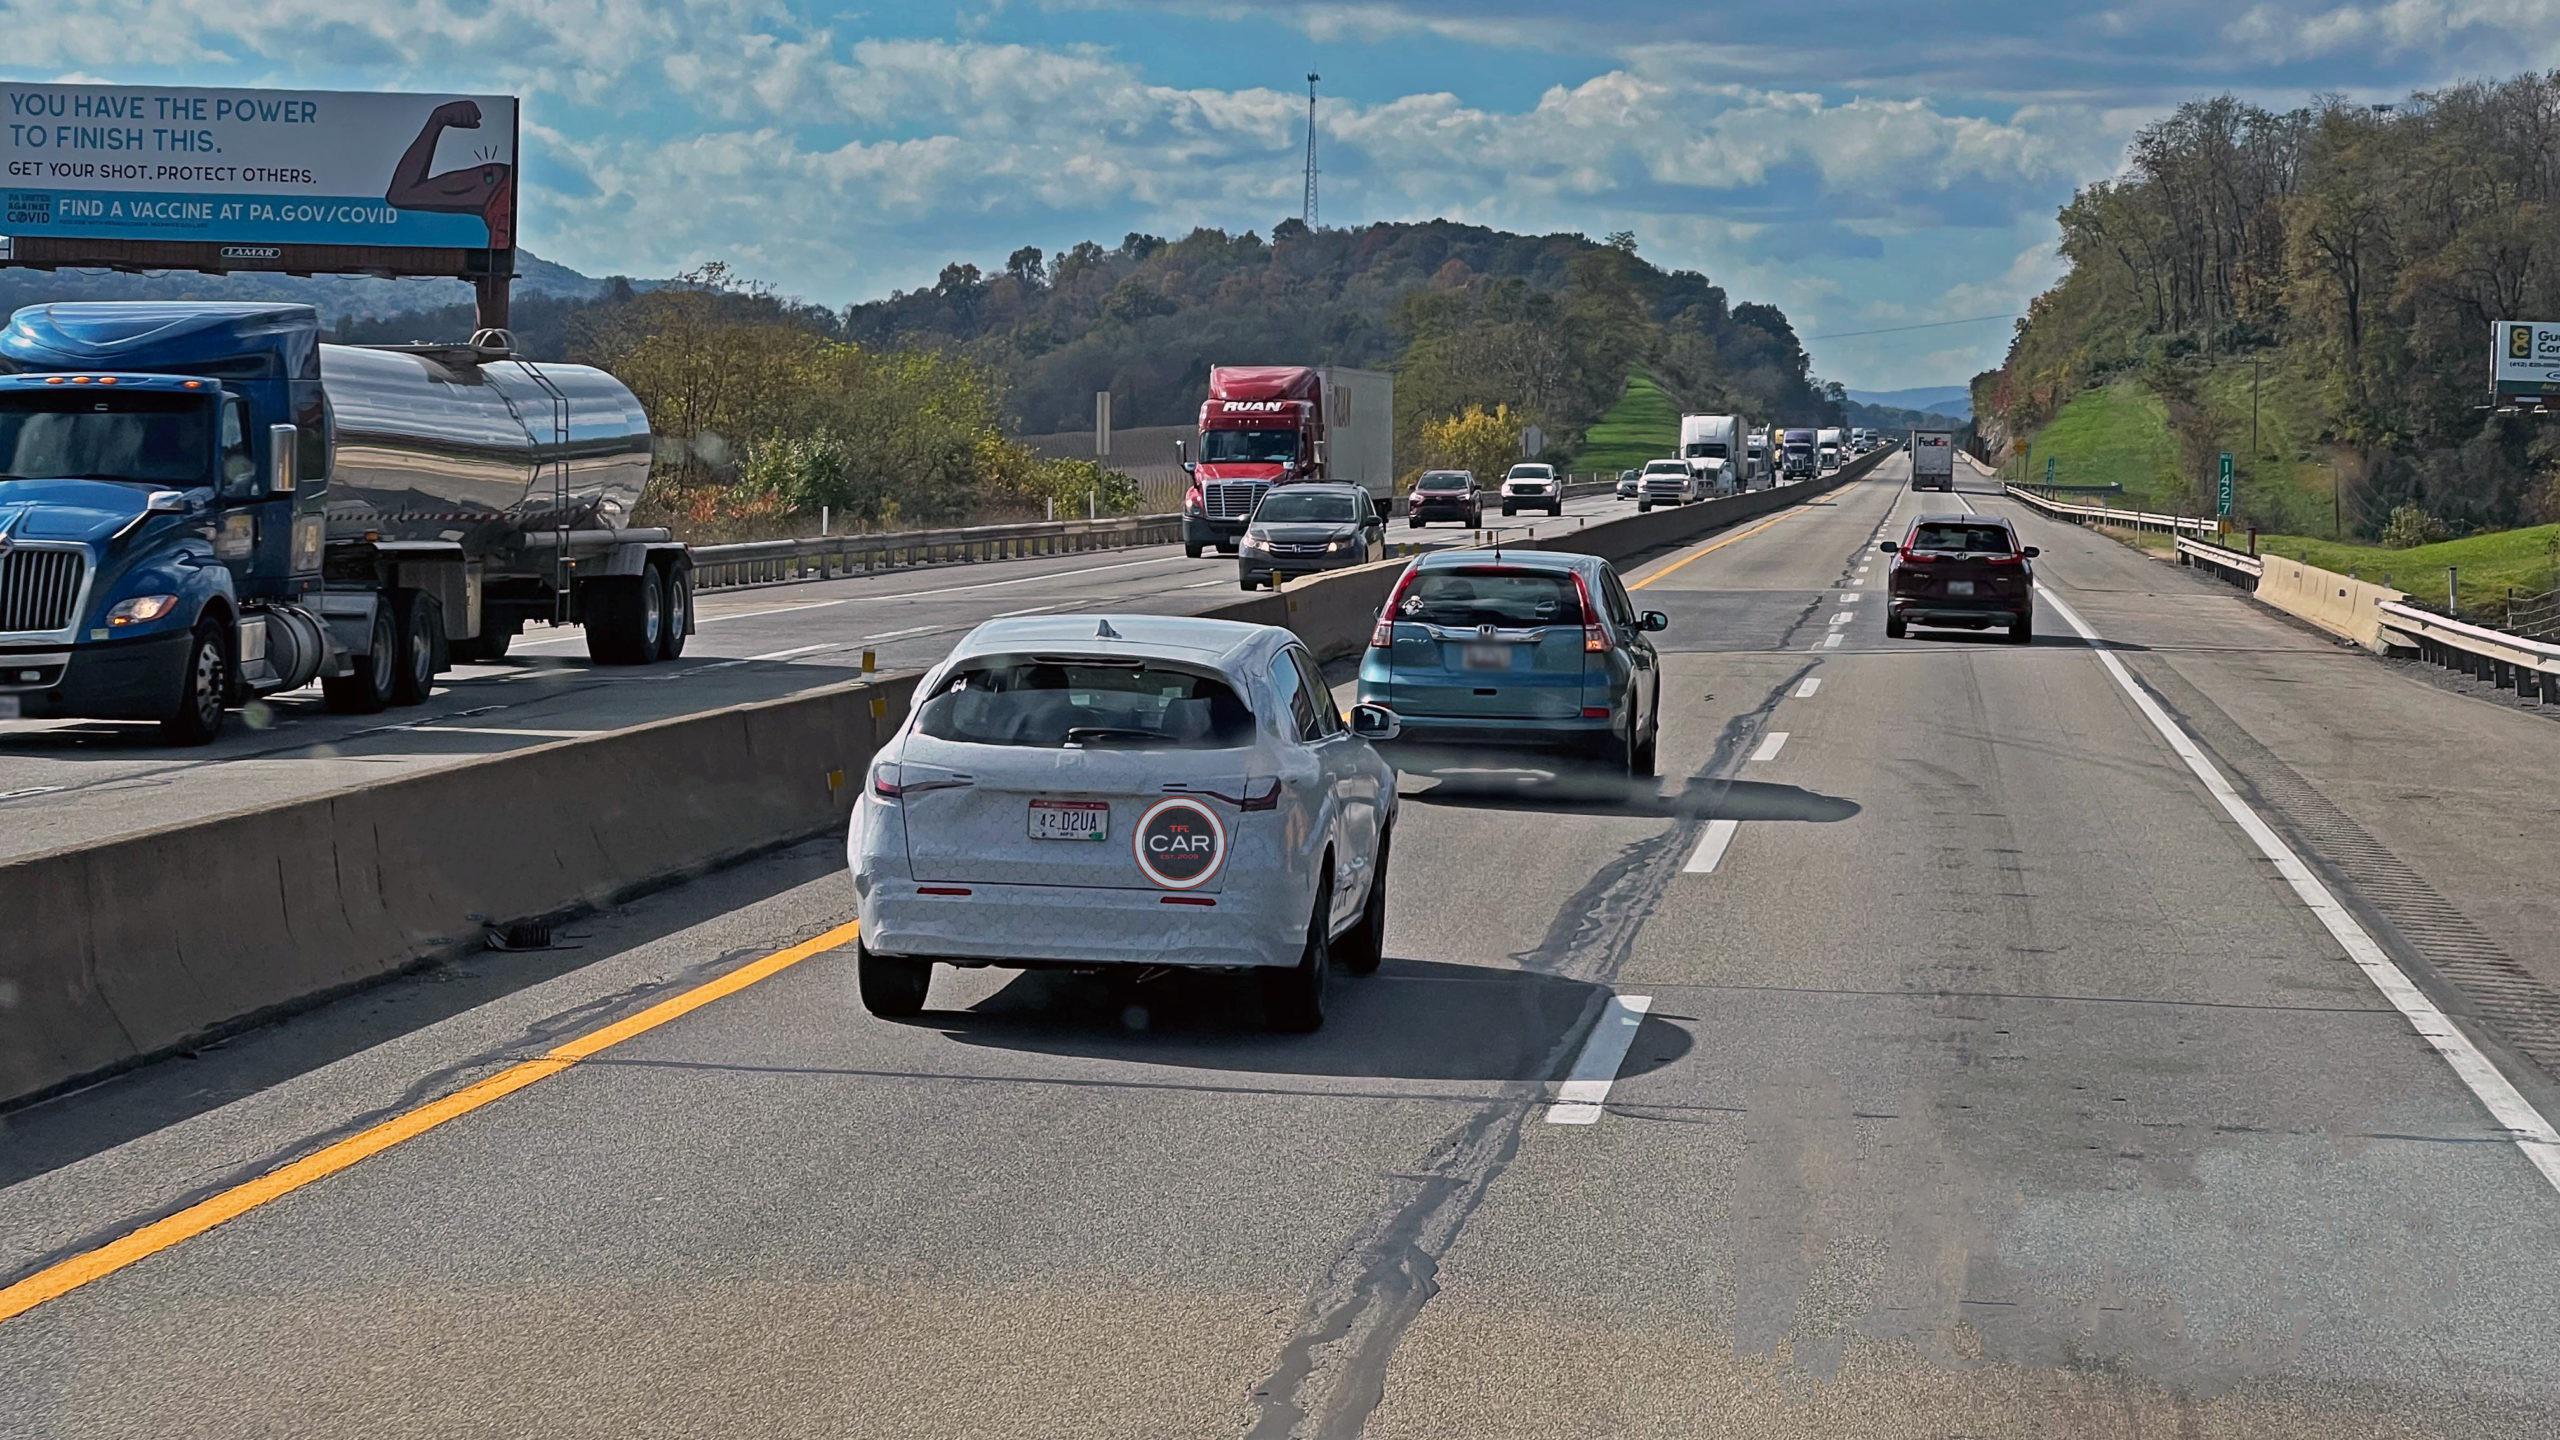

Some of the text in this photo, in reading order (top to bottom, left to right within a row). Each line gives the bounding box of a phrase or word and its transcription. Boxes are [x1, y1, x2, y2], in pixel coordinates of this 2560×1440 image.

[10, 93, 317, 123] YOU HAVE THE POWER
[9, 124, 222, 153] TO FINISH THIS.
[8, 161, 317, 184] GET YOUR SHOT. PROTECT OTHERS.
[7, 211, 50, 223] COVID
[59, 199, 398, 224] FIND A VACCINE AT PA.GOV/COVID
[1222, 401, 1282, 412] RUAN
[1919, 436, 1948, 447] FedEx
[1062, 811, 1097, 831] D2UA
[1169, 825, 1190, 833] TFL
[1149, 834, 1210, 852] CAR
